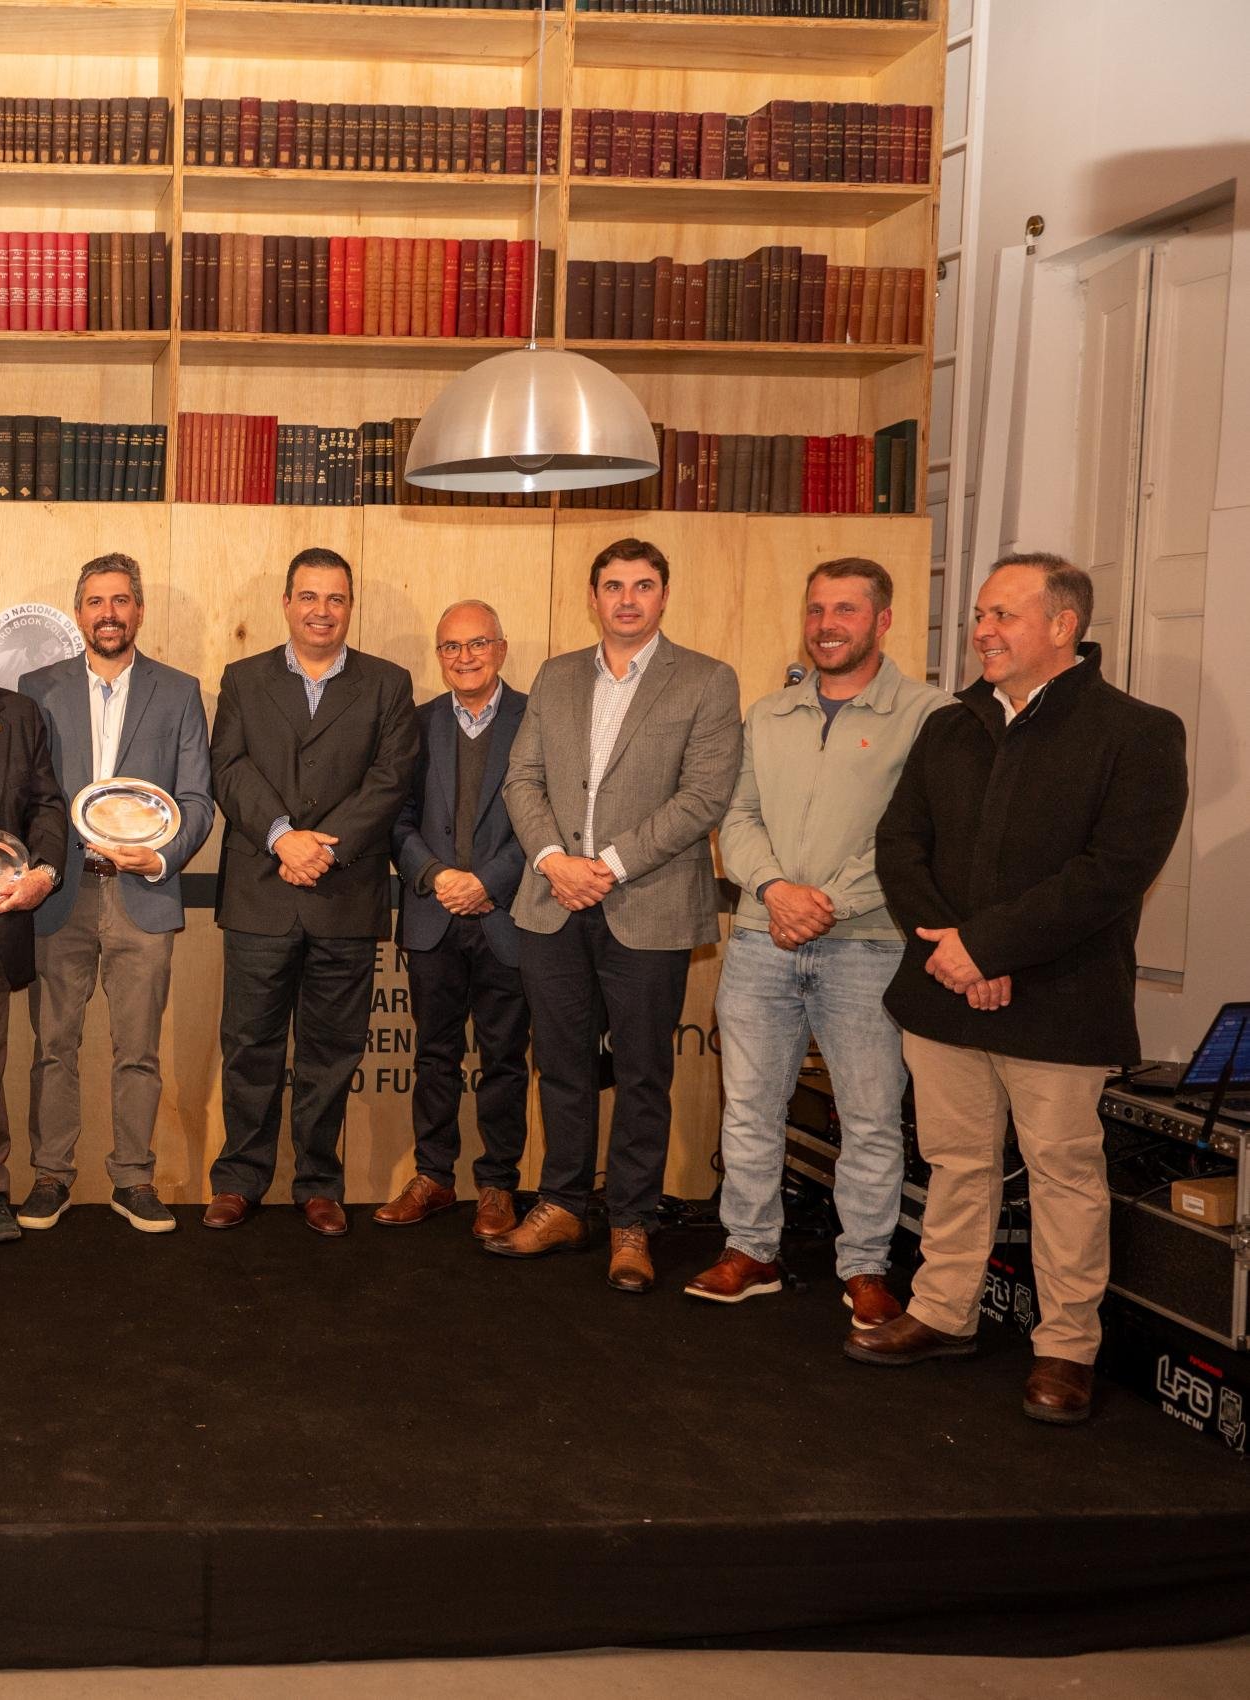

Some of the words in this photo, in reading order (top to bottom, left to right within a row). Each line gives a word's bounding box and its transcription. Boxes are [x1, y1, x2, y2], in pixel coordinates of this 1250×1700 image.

[11, 605, 63, 623] NACIONAL
[63, 621, 75, 633] DE
[44, 620, 72, 659] COLLARE
